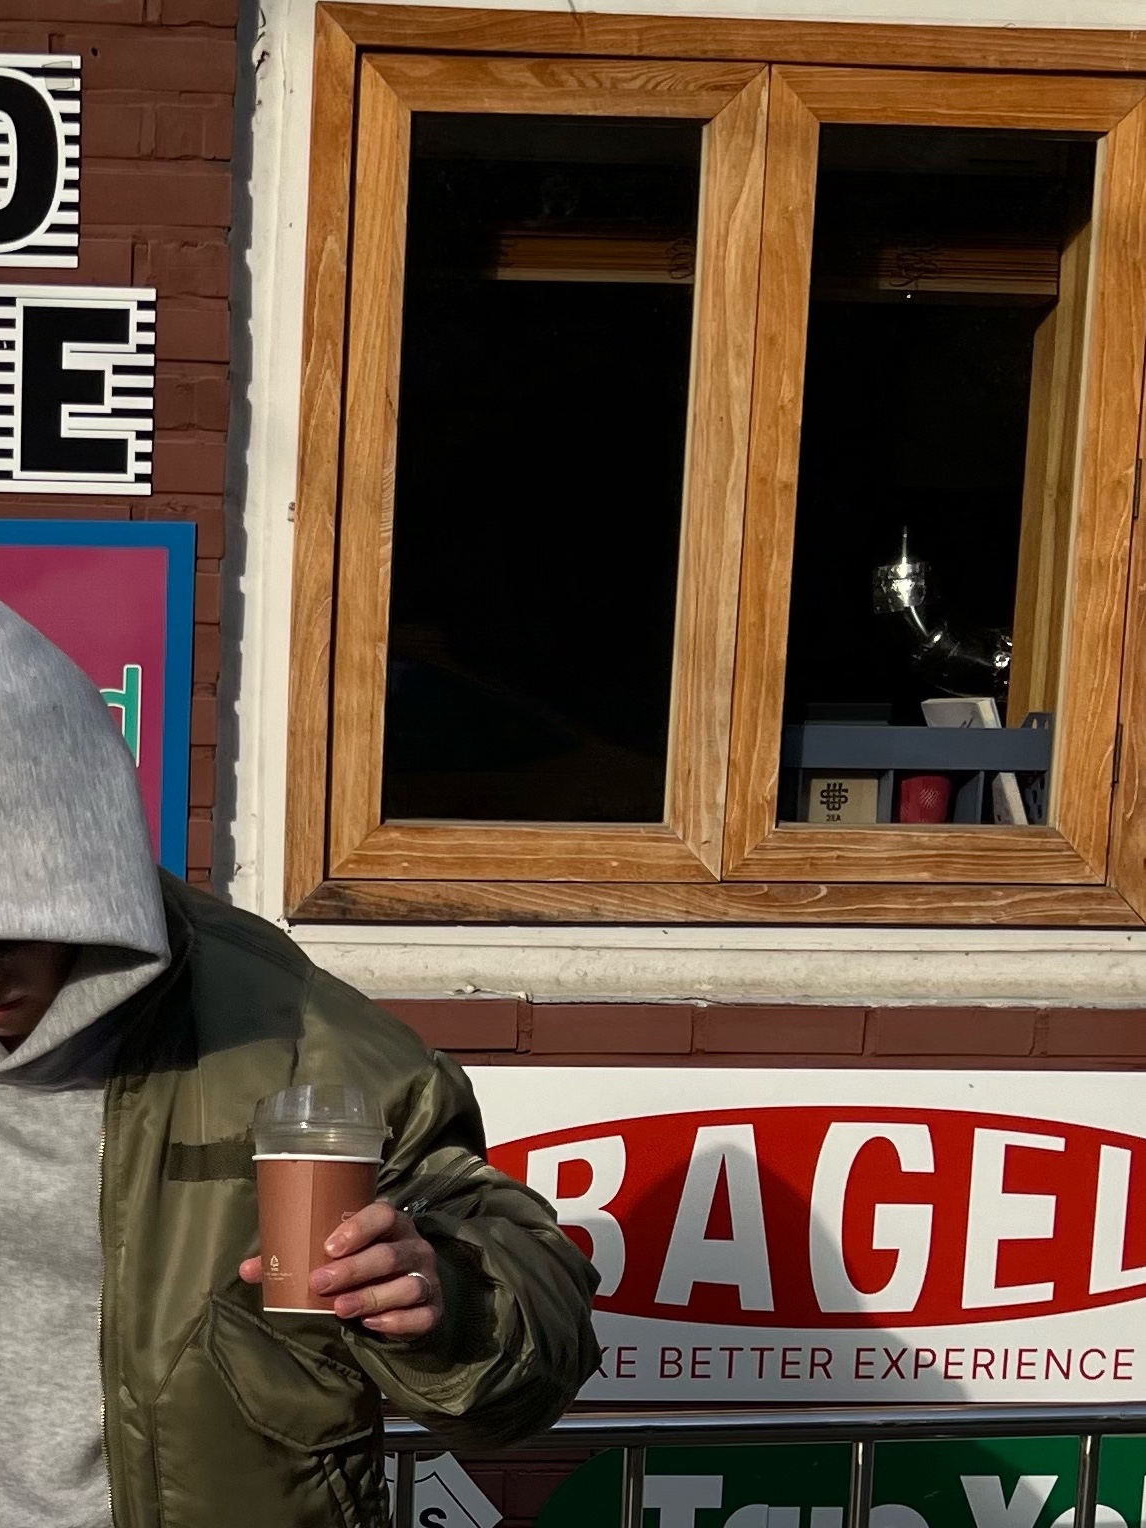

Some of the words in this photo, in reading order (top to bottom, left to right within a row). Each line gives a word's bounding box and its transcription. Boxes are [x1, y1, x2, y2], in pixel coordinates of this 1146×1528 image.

[526, 1121, 1146, 1313] BAGEL
[659, 1346, 833, 1379] BETTER
[854, 1346, 1135, 1382] EXPERIENCE
